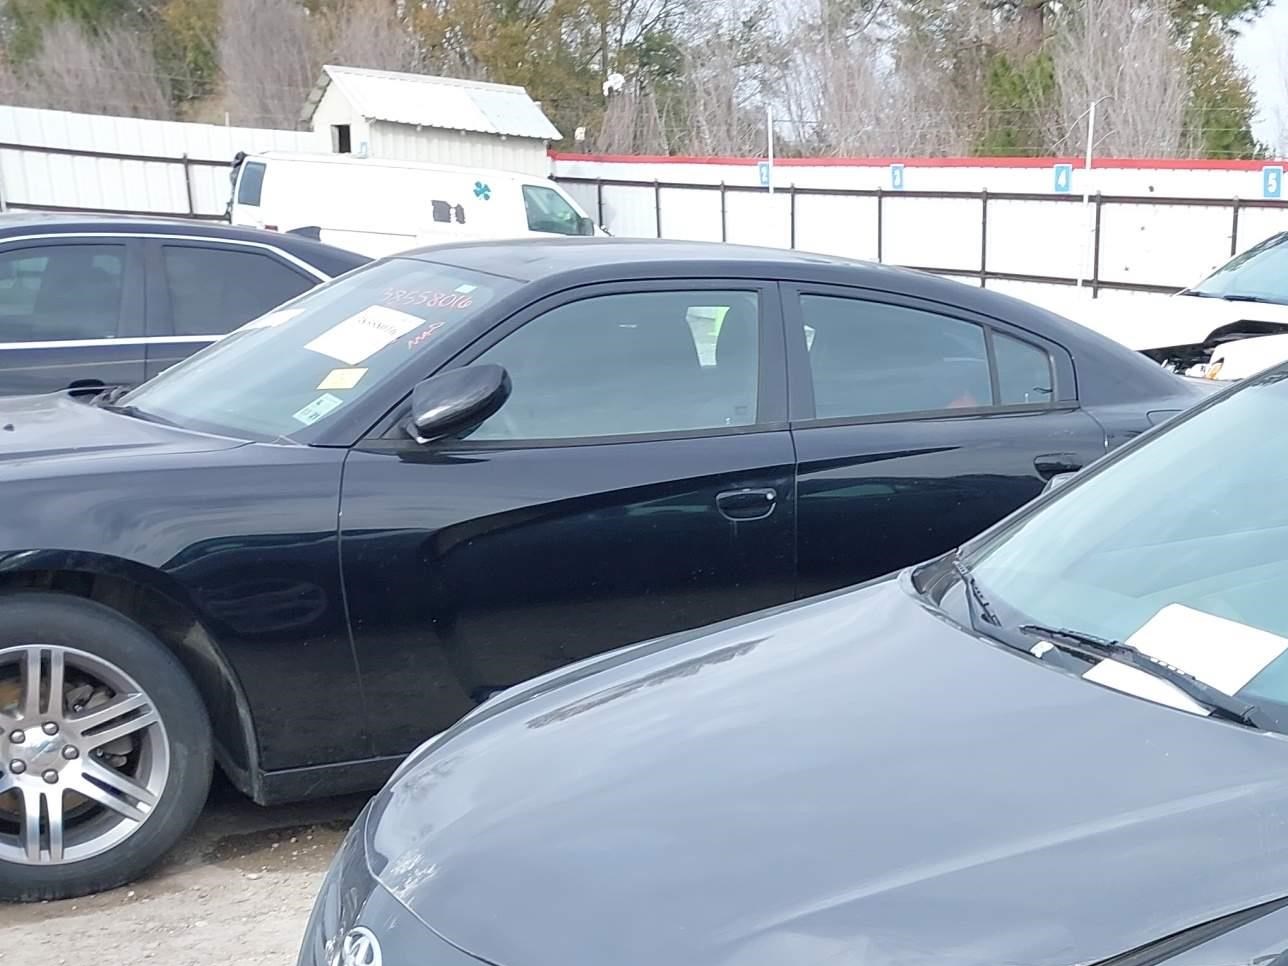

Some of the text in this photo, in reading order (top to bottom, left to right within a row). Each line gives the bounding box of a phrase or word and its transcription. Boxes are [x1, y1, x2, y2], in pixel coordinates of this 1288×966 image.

[761, 166, 768, 182] 2
[1058, 169, 1066, 188] 4
[1267, 172, 1277, 193] 5
